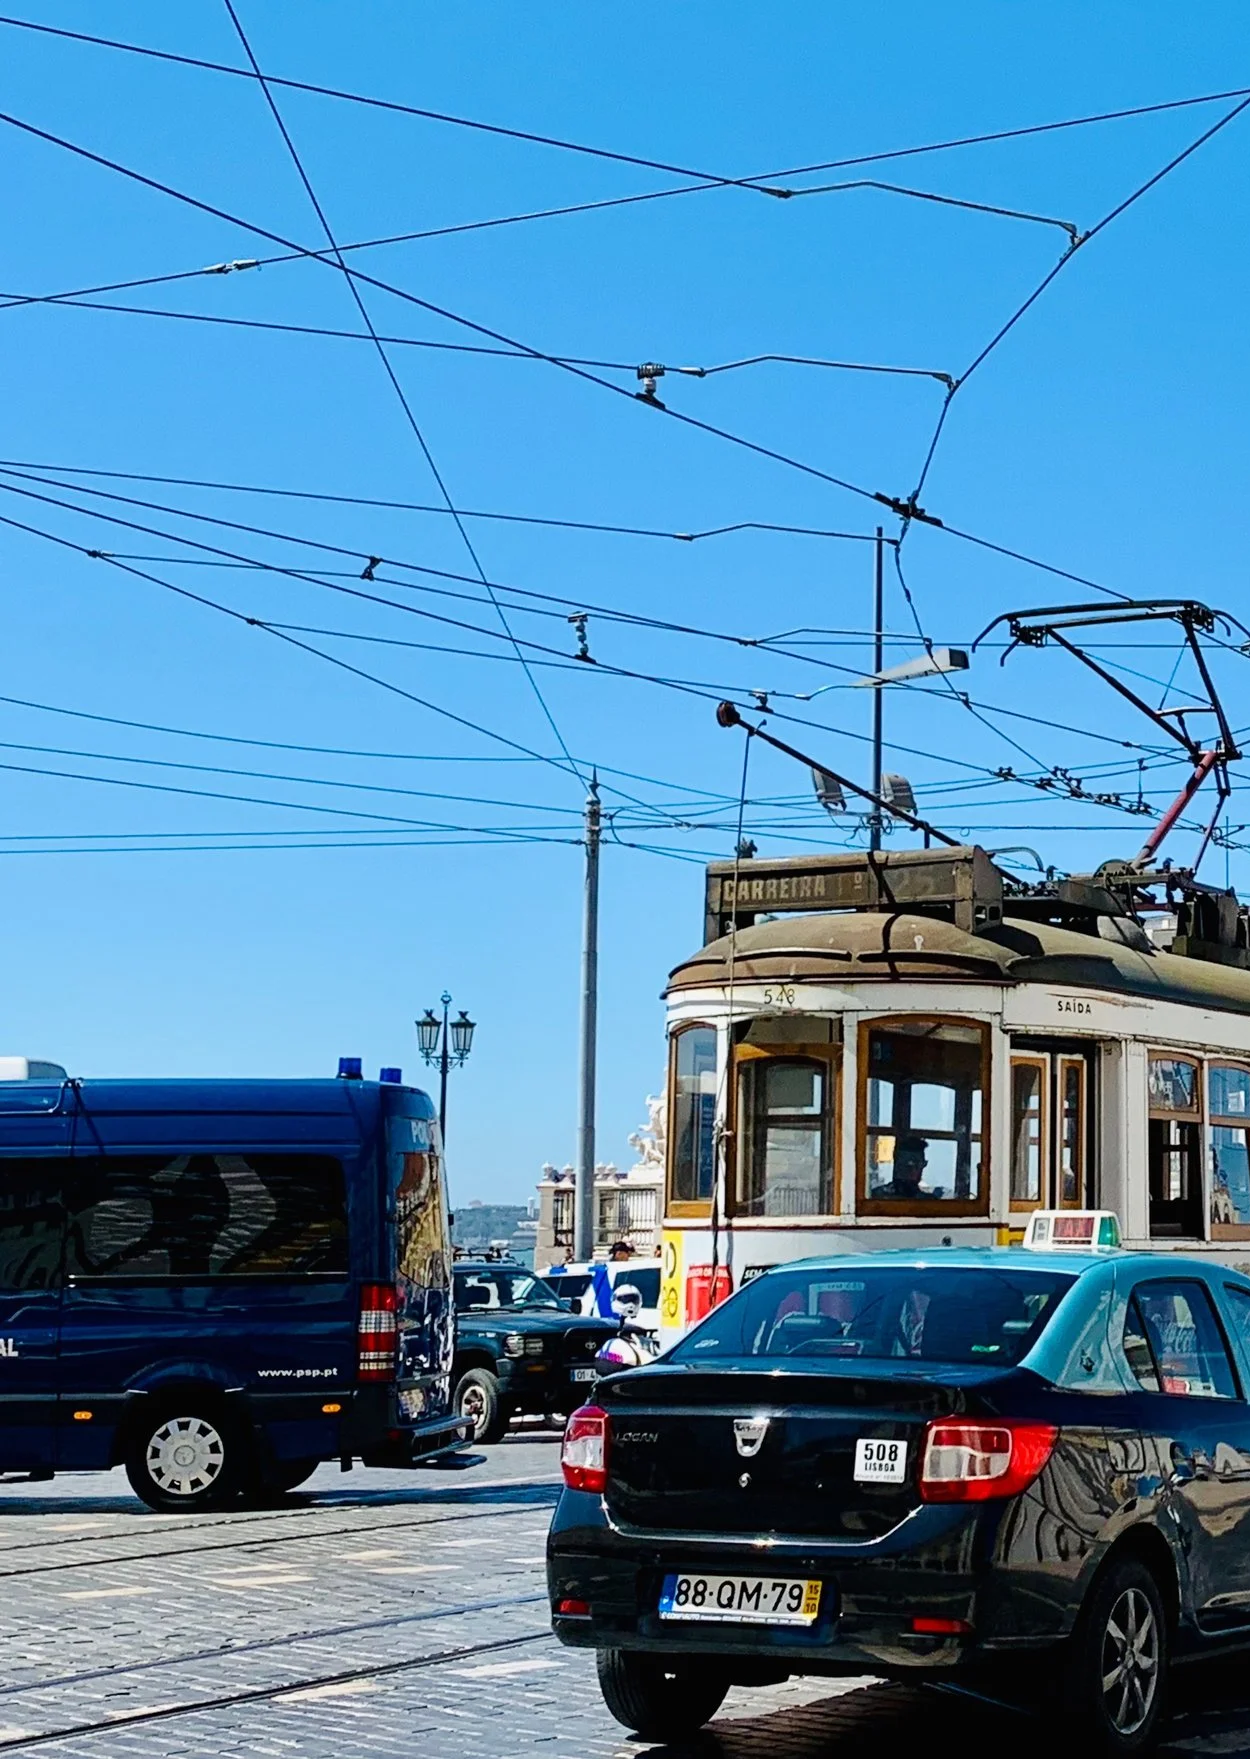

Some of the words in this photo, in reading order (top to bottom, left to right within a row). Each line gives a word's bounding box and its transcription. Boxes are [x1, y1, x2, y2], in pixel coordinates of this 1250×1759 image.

[723, 875, 826, 901] CARREIRA
[764, 988, 796, 1005] 548
[1057, 998, 1092, 1015] SAÍDA
[257, 1367, 338, 1378] www.psp.pt
[864, 1442, 898, 1462] 508
[864, 1462, 895, 1472] LISBOA
[808, 1584, 819, 1595] 15
[805, 1602, 817, 1613] 10
